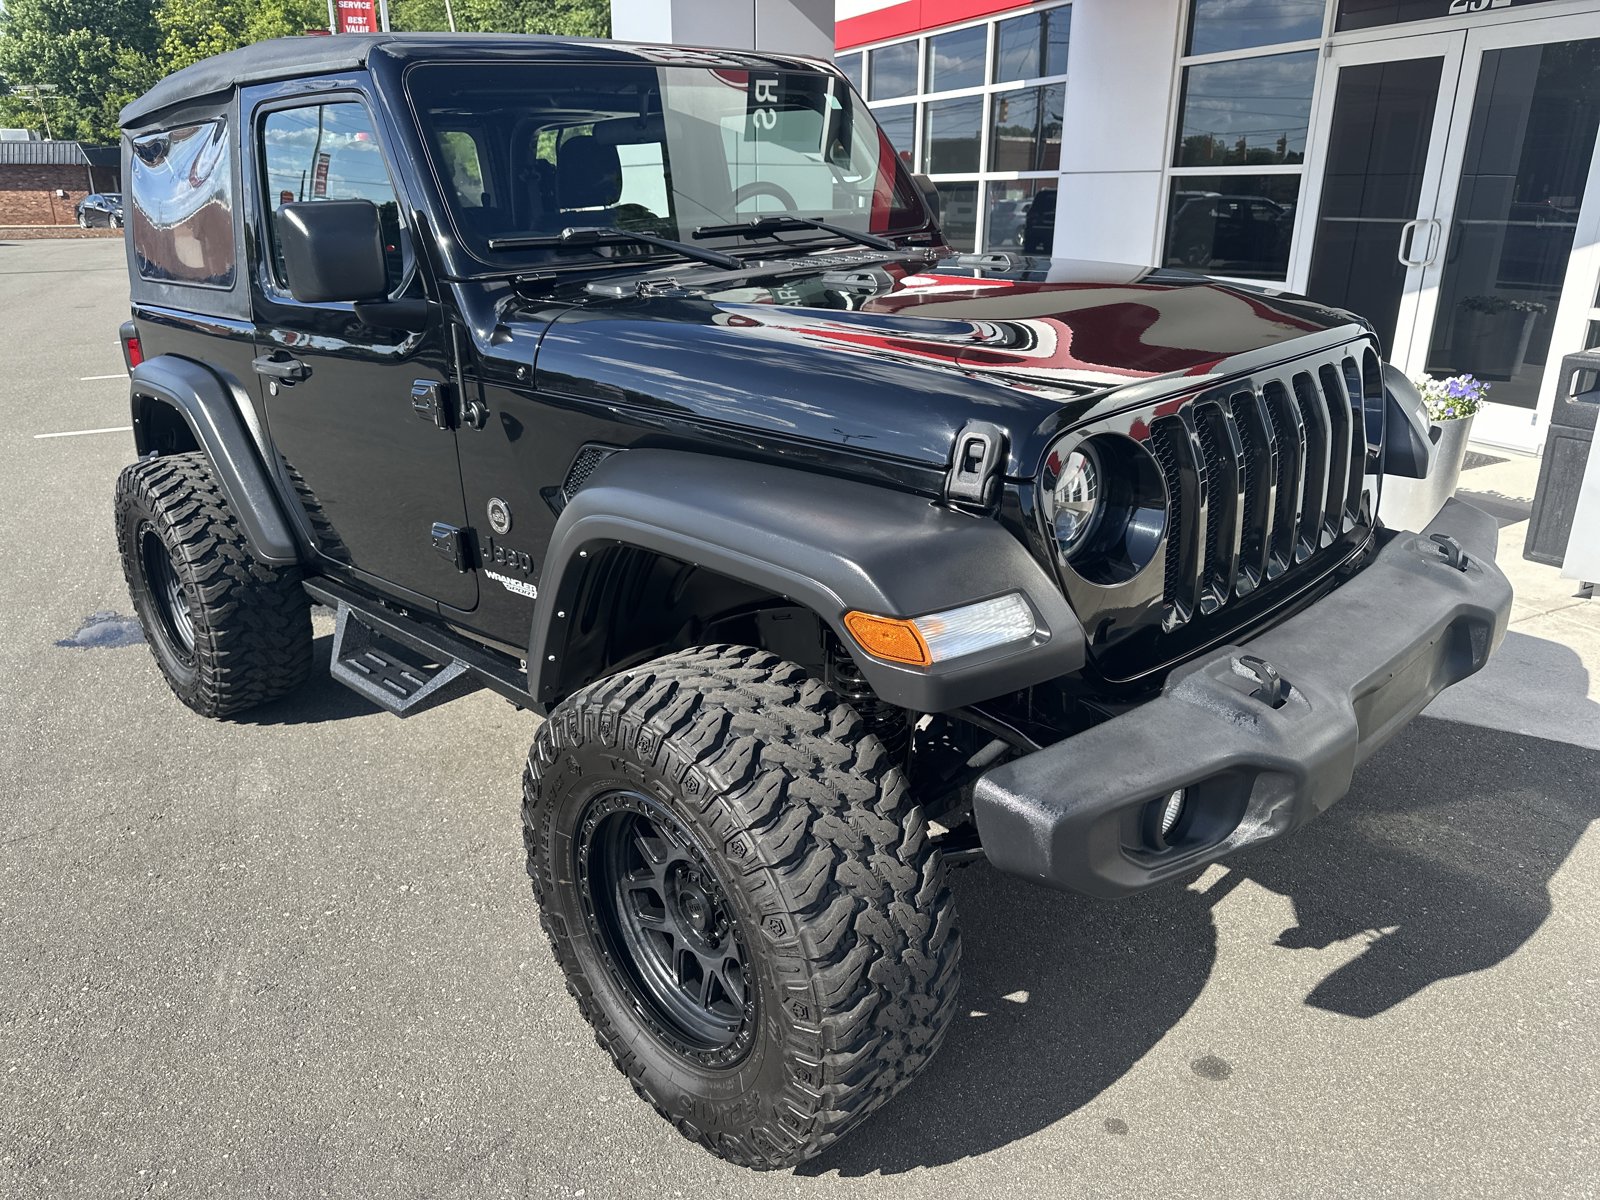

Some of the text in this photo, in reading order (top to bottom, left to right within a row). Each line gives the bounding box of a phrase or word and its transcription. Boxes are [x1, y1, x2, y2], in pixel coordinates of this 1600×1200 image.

[338, 0, 371, 9] SERVICE
[347, 16, 367, 24] BEST
[345, 25, 370, 33] VALUE
[480, 535, 534, 578] Jeep
